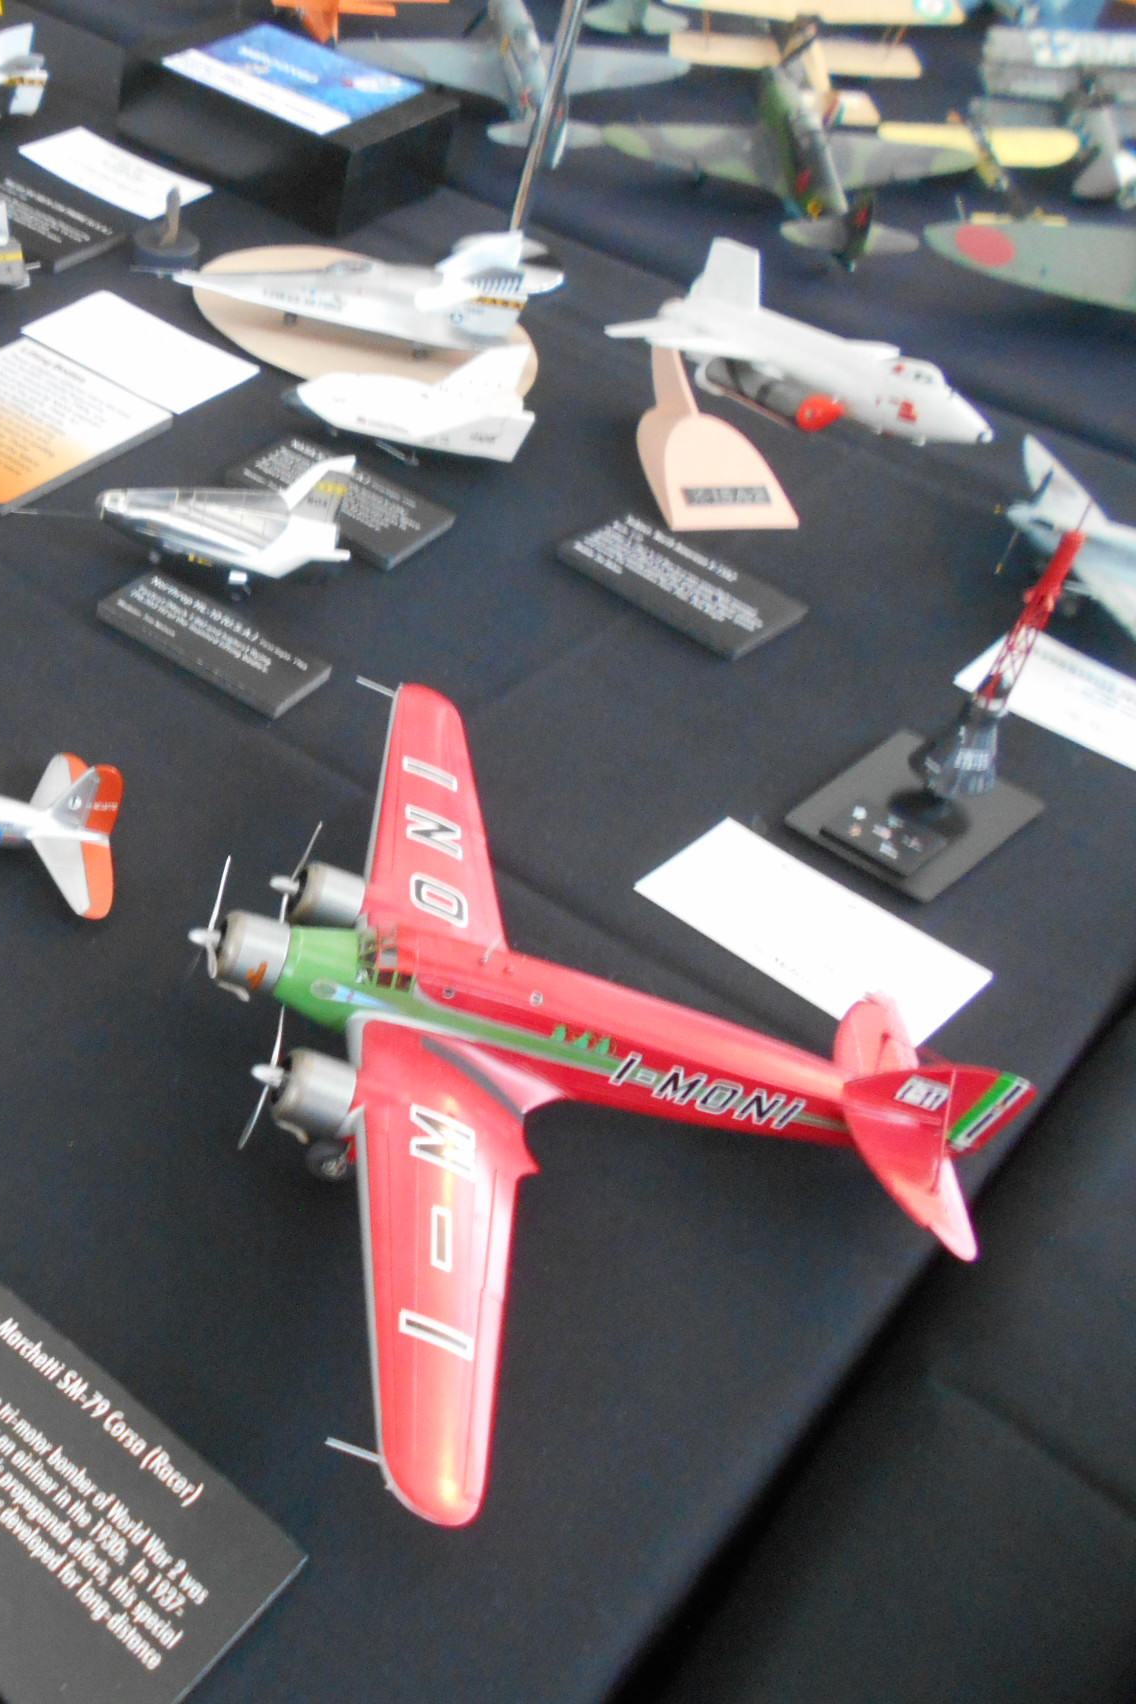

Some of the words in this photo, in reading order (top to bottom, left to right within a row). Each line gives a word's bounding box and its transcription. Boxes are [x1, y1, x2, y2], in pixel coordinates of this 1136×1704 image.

[607, 1051, 807, 1131] I-MONI
[57, 1371, 111, 1418] SM-79
[104, 1412, 147, 1456] Corsa
[140, 1446, 204, 1507] (Racer)
[11, 1451, 59, 1495] airliner
[53, 1486, 72, 1509] in
[67, 1500, 92, 1528] the
[130, 1559, 149, 1583] In
[47, 1446, 97, 1497] bomber
[92, 1492, 116, 1511] of
[107, 1500, 151, 1545] World
[143, 1534, 173, 1569] War
[167, 1560, 187, 1581] 2
[179, 1573, 209, 1605] was
[0, 1507, 68, 1571] developed
[58, 1560, 83, 1589] for
[76, 1579, 162, 1670] long-distance
[68, 1539, 111, 1586] efforts,
[109, 1576, 137, 1608] this
[132, 1602, 183, 1649] special
